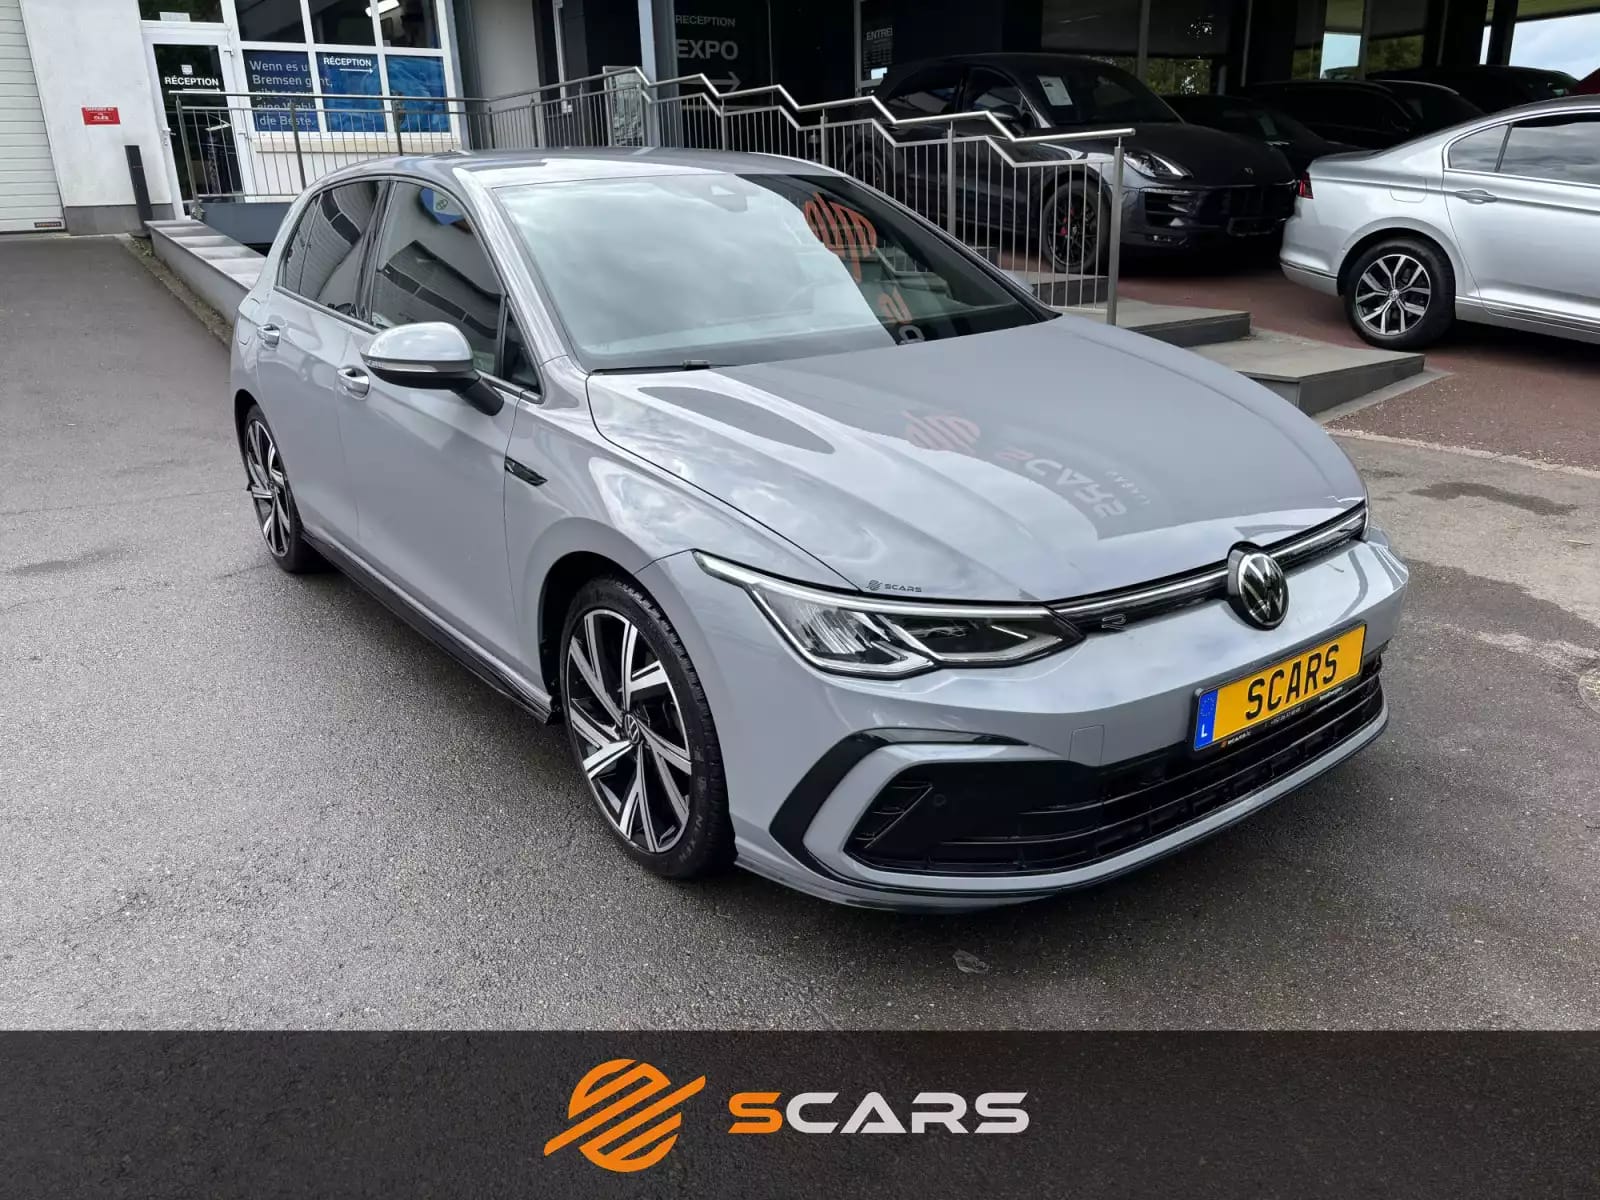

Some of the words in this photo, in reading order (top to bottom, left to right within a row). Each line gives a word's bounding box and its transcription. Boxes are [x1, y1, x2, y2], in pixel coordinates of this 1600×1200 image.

[676, 38, 739, 60] EXPO
[249, 60, 282, 71] Wenn
[286, 63, 298, 72] es
[323, 56, 372, 67] RÉCEPTION
[164, 75, 219, 86] RÉCEPTION
[252, 74, 302, 85] Bremsen
[884, 583, 922, 593] SCARS
[1245, 644, 1339, 720] SCARS
[1201, 724, 1208, 738] L
